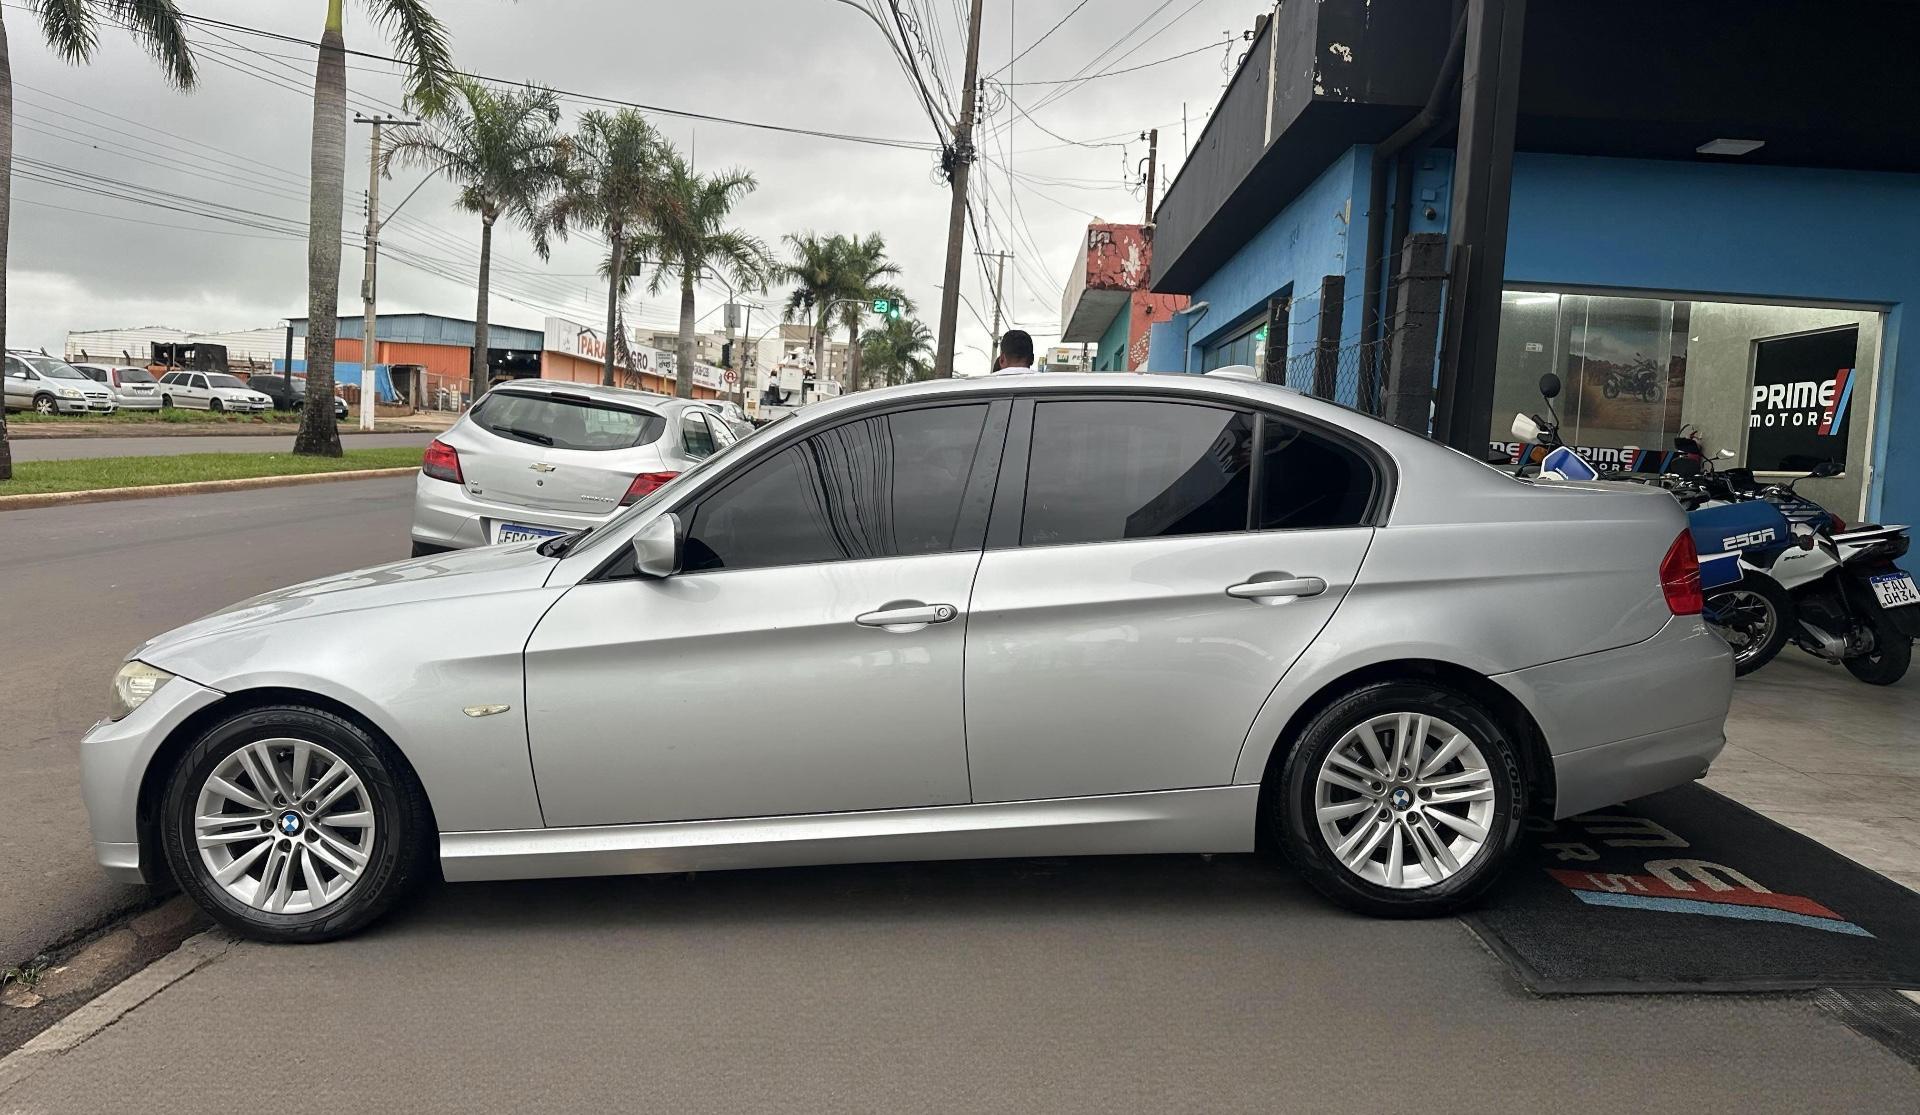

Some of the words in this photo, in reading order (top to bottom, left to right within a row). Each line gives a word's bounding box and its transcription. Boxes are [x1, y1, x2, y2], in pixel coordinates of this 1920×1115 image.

[874, 300, 888, 313] 23
[1751, 379, 1837, 411] PRIME
[1749, 411, 1833, 428] MOTORS
[1570, 446, 1634, 463] RIME
[1722, 527, 1776, 551] 250R
[1882, 579, 1908, 592] FAU
